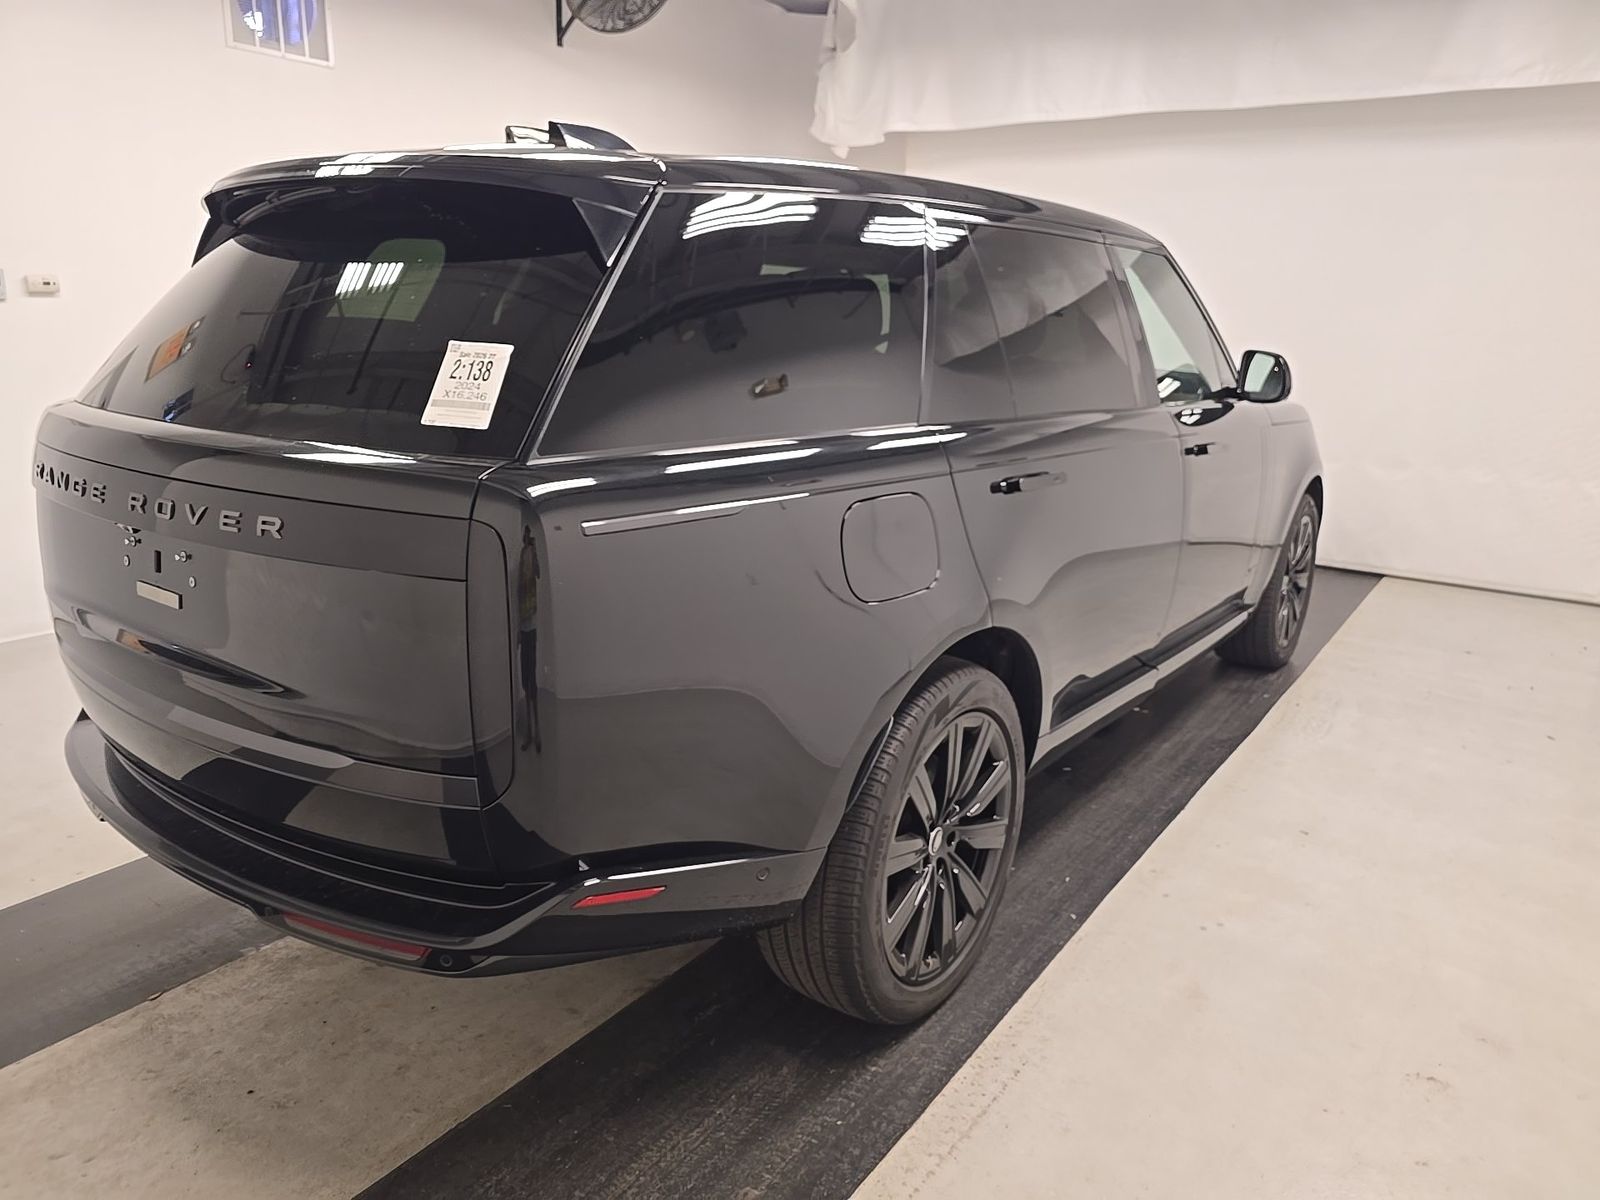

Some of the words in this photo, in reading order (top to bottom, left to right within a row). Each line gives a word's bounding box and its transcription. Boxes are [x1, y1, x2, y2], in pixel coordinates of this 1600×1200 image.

[449, 359, 494, 382] 2:138
[454, 381, 481, 391] 2024
[34, 462, 107, 504] RANGE
[127, 491, 285, 540] ROVER
